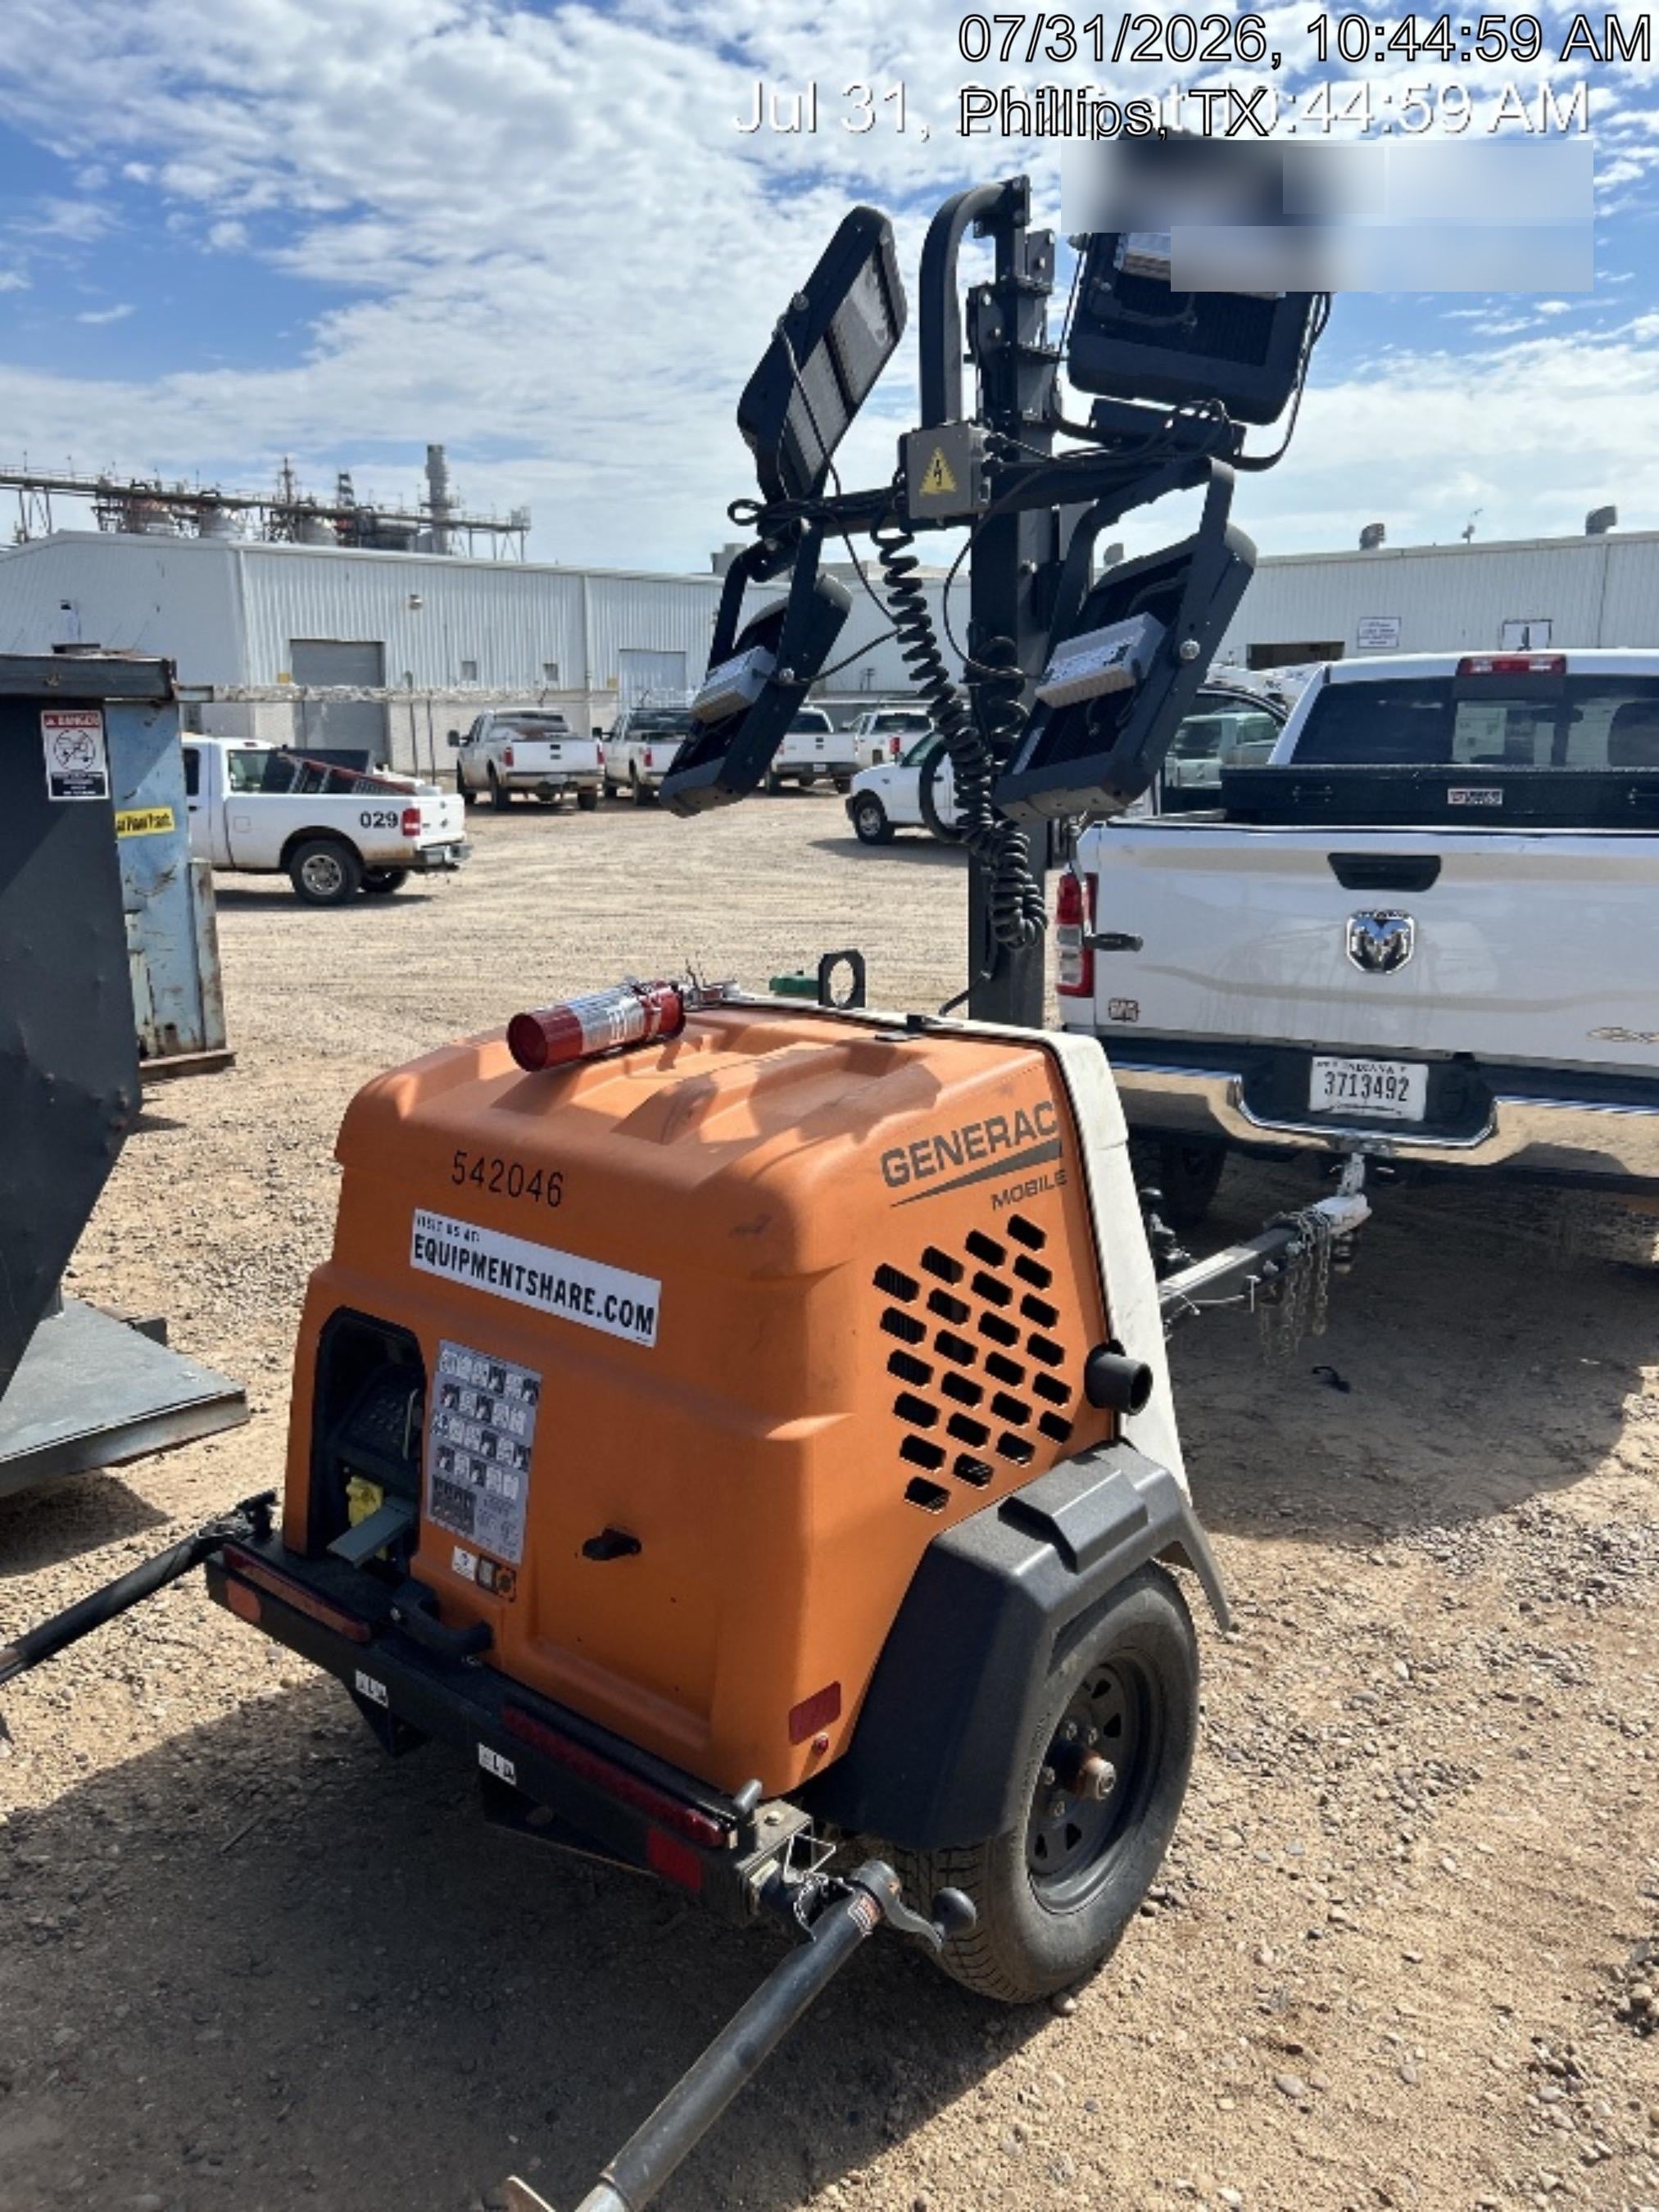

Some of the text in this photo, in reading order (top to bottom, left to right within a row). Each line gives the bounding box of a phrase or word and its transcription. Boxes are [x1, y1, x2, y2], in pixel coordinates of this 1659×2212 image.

[360, 810, 399, 828] 029
[1324, 1071, 1410, 1102] 3713492
[880, 1100, 1058, 1187] GENERAC
[451, 1149, 564, 1208] 542046
[990, 1169, 1068, 1211] MOBILE
[414, 1233, 655, 1336] EQUIPMENTSHARE.COM
